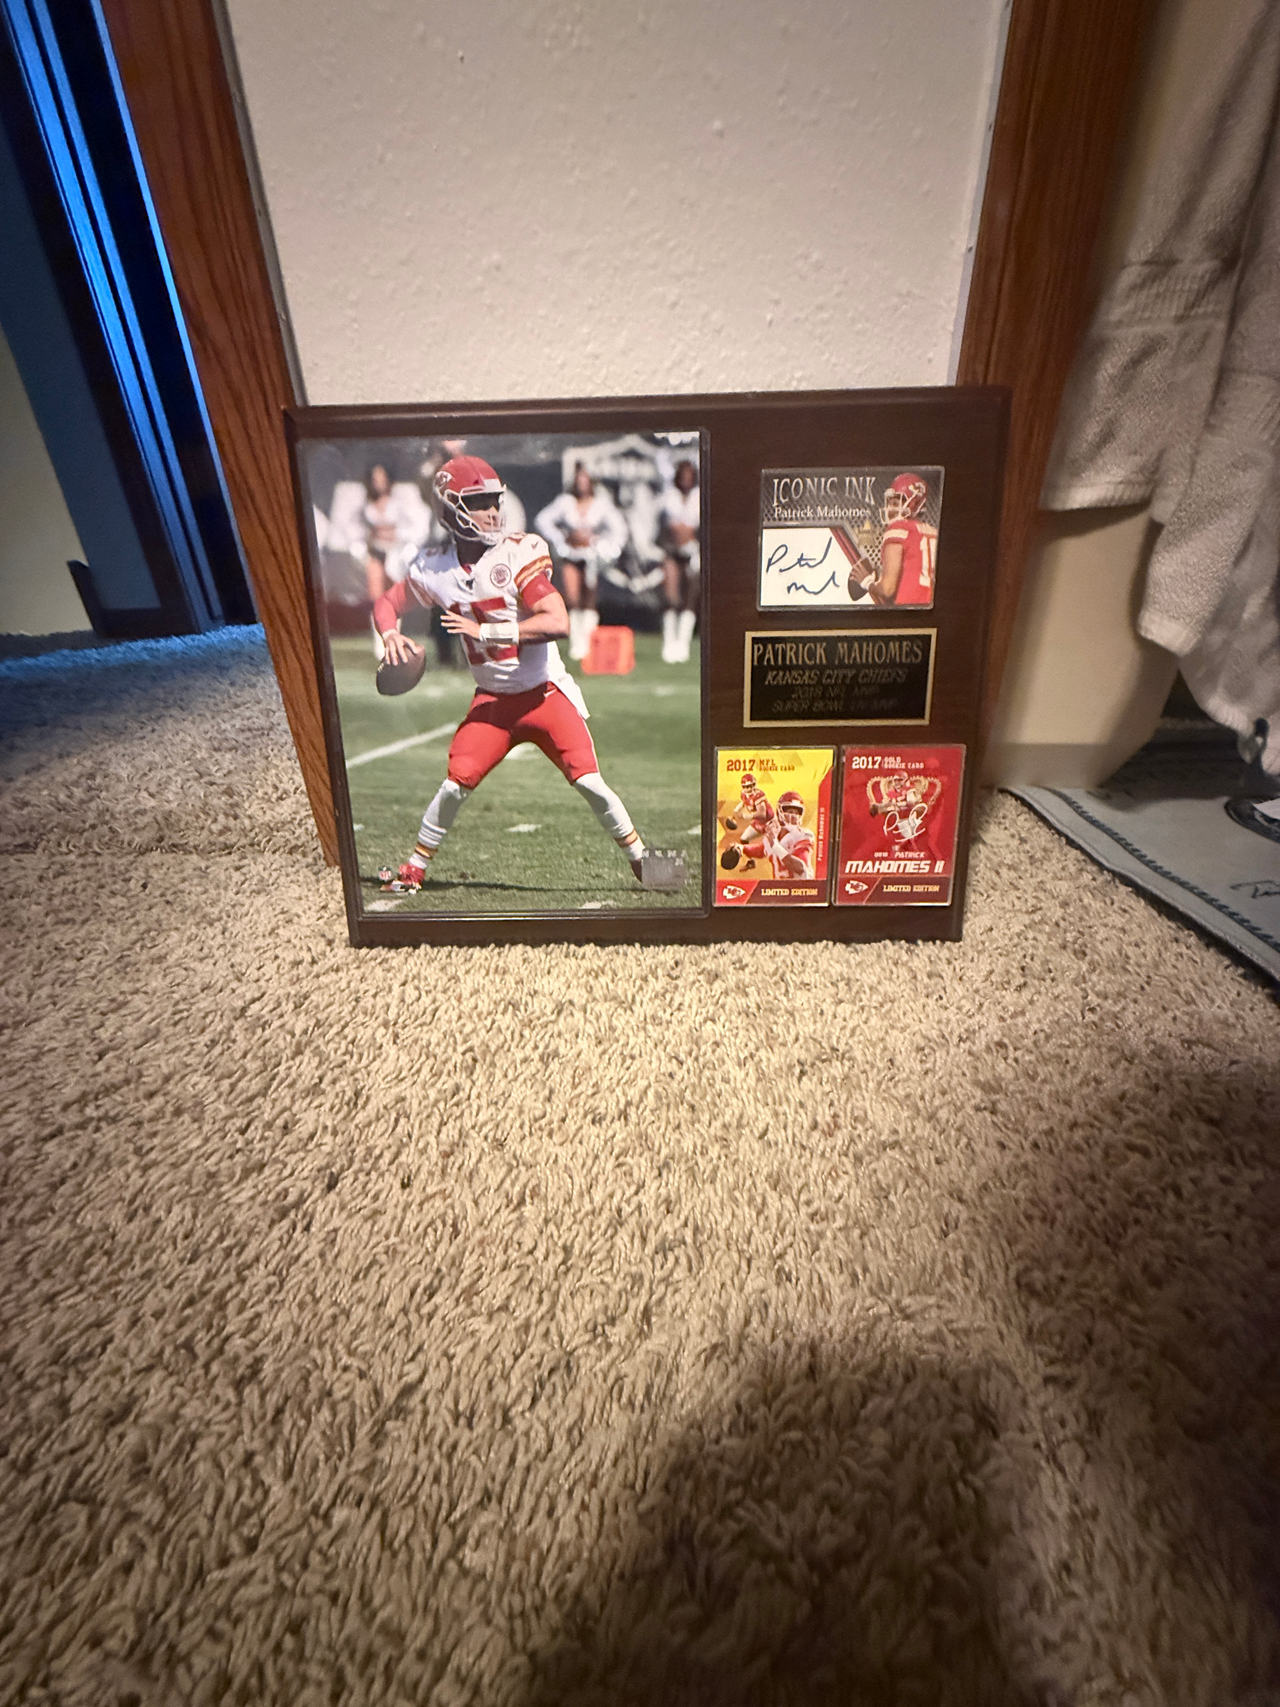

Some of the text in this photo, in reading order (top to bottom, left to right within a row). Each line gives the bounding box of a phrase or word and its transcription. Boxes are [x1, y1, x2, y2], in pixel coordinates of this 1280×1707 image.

[772, 476, 876, 507] ICONIC INK
[774, 505, 871, 518] Patrick Mahomes
[753, 640, 922, 666] PATRICK MAHOMES
[765, 667, 908, 686] KANSAS CITY CHIEFS
[726, 759, 756, 772] 2017
[851, 756, 882, 769] 2017
[895, 851, 926, 859] PATRICK
[845, 860, 945, 874] MAHOMES II
[761, 888, 818, 896] LIMITED EDITION
[883, 884, 940, 892] LIMITED EDITION
